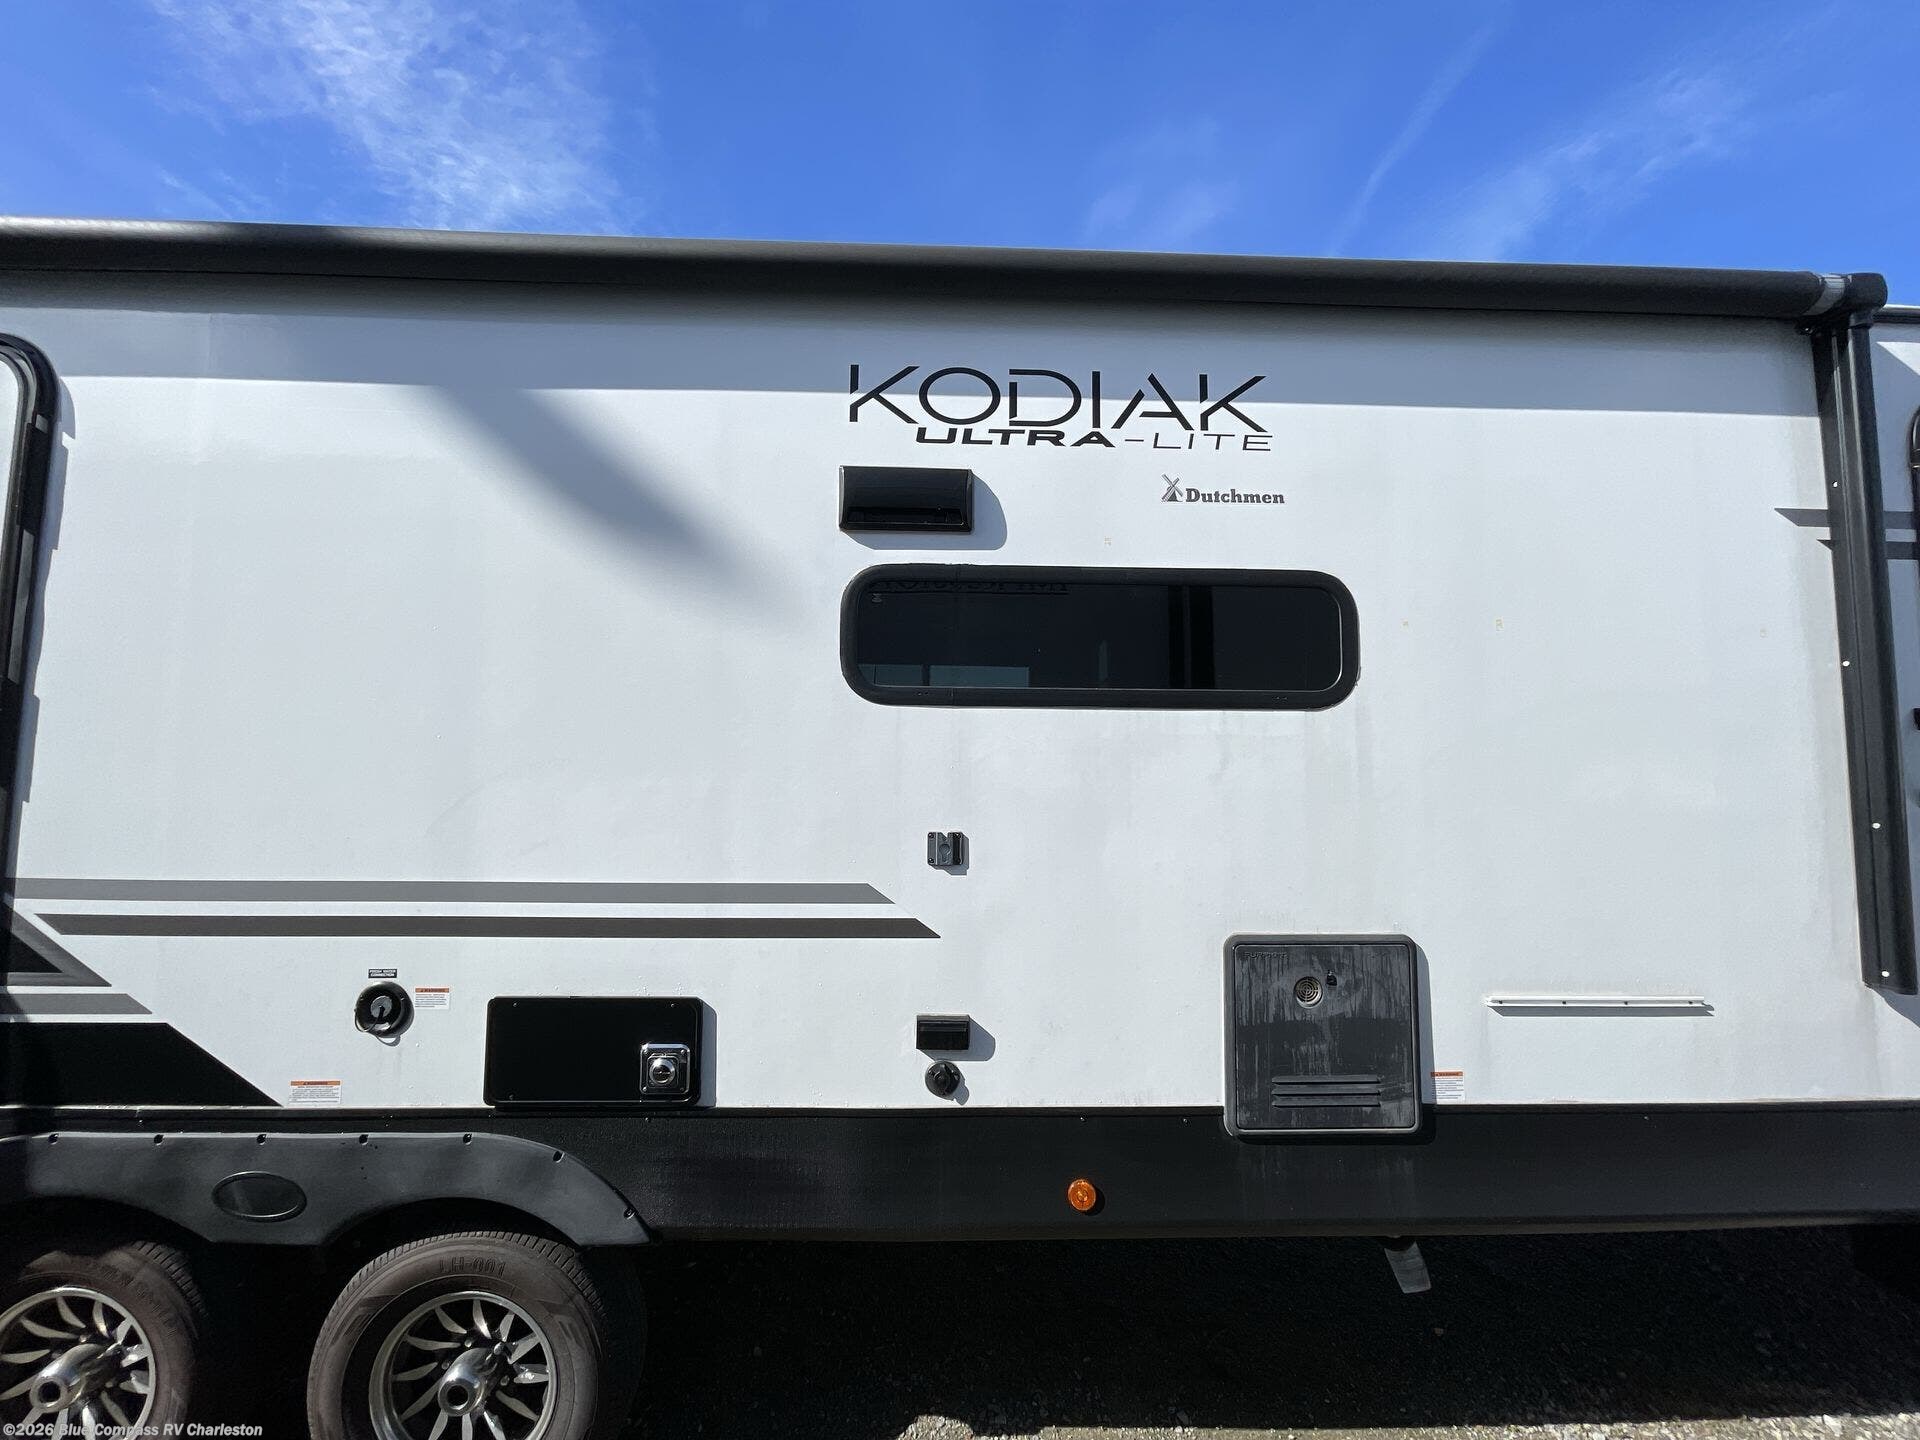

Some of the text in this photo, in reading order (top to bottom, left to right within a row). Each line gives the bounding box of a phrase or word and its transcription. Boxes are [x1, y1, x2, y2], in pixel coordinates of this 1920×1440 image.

[849, 364, 1268, 433] KODIAK
[915, 427, 1274, 452] ULTRA-LITE
[1184, 487, 1285, 504] Dutchmen
